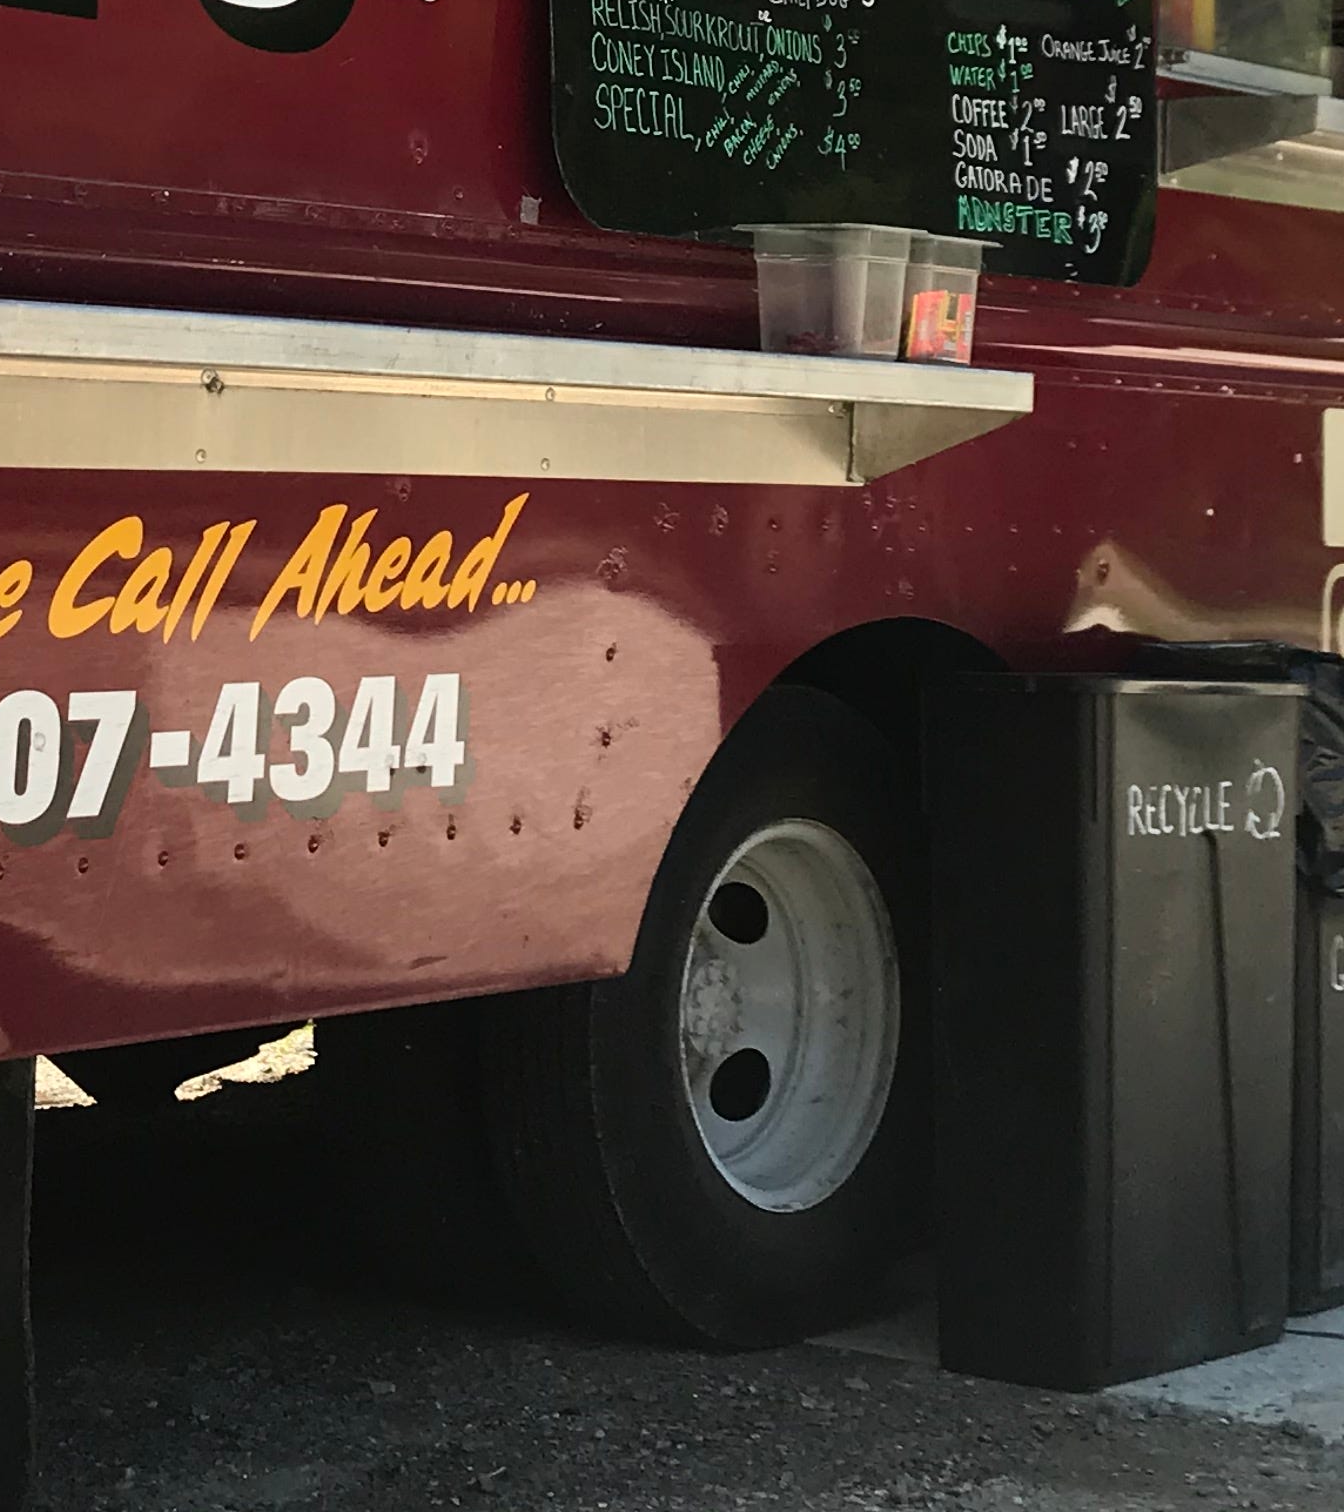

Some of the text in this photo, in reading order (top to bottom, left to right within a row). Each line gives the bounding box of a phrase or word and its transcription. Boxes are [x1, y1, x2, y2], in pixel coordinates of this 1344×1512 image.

[591, 31, 655, 80] CONEY
[766, 23, 822, 65] ONIONS
[947, 32, 992, 57] CHIPS
[1041, 34, 1097, 62] ORANGE
[1097, 39, 1131, 65] JUICE
[949, 63, 996, 91] WATER
[951, 93, 1009, 129] COFFEE
[1060, 104, 1108, 140] LARGE
[952, 129, 998, 162] SODA
[955, 161, 1054, 202] GATORADE
[957, 195, 1074, 245] MONSTER
[47, 515, 259, 643] Call
[249, 491, 536, 645] Ahead...
[1128, 780, 1234, 838] RECYCLE
